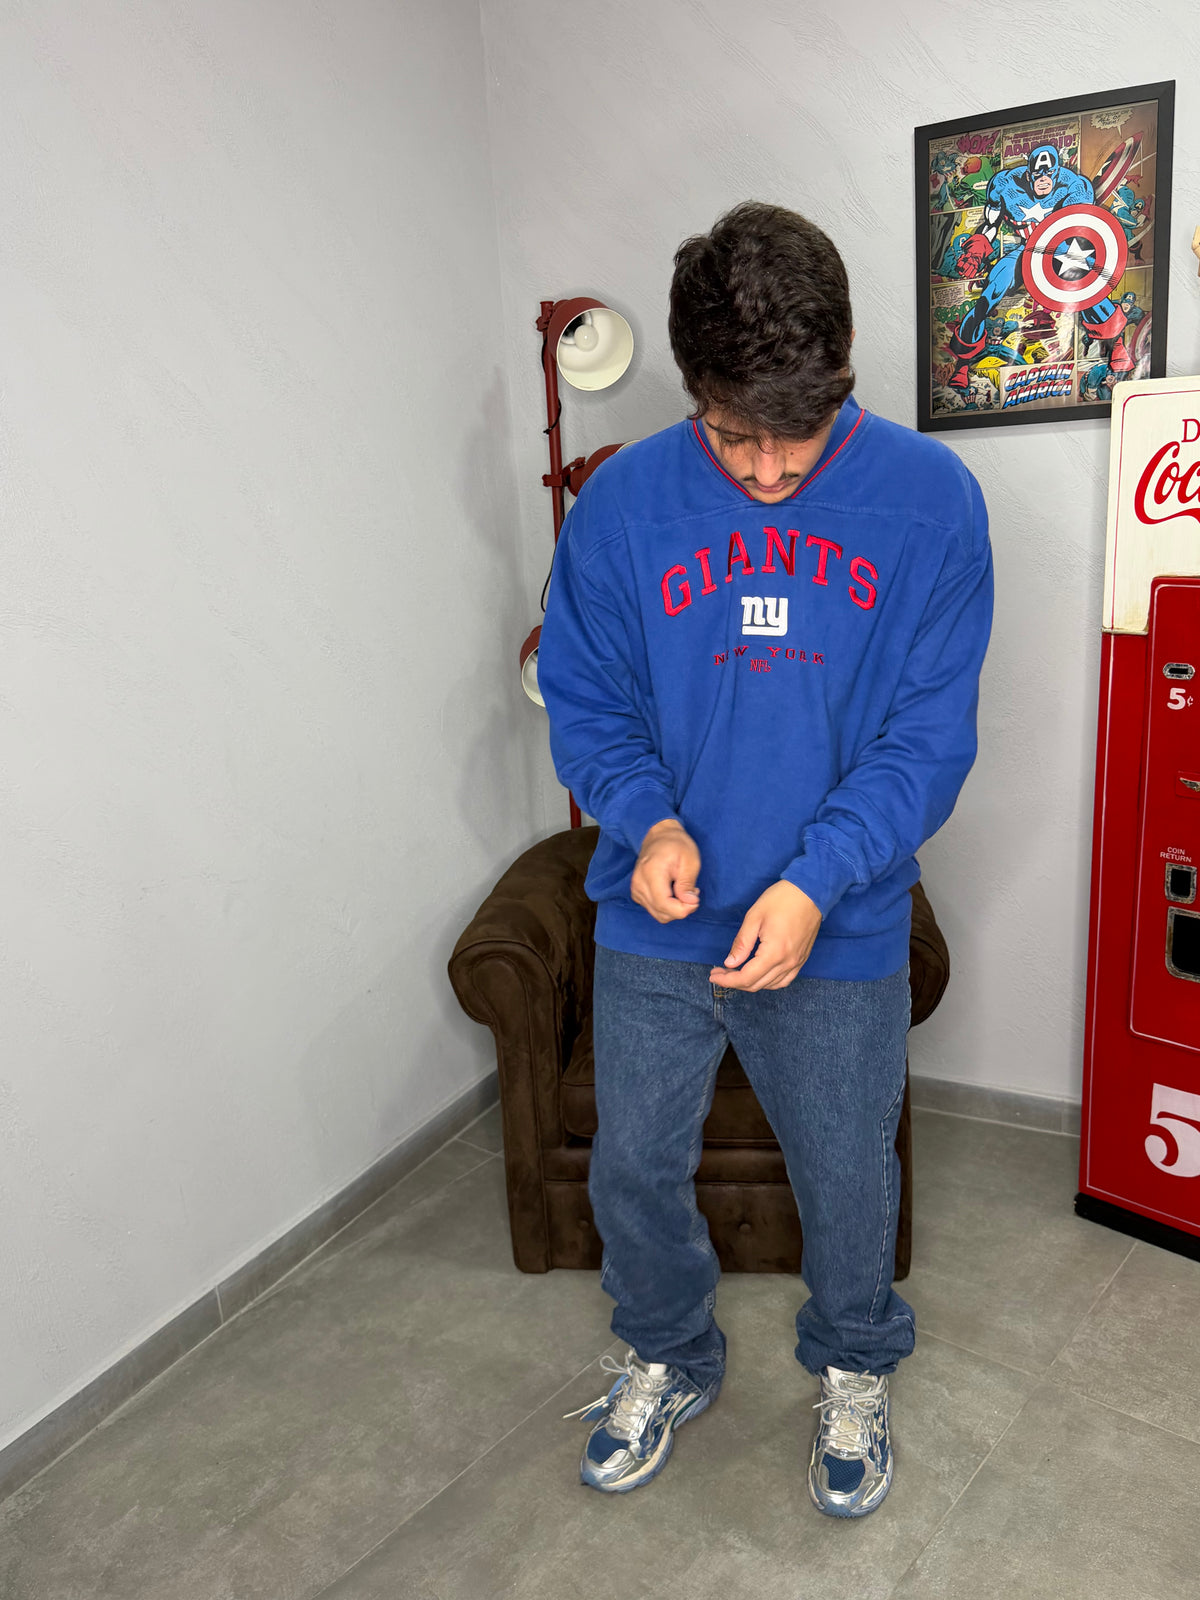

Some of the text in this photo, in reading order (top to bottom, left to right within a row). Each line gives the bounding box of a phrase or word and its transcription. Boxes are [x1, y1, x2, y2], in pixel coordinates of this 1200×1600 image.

[1004, 363, 1075, 392] CAPTAIN
[1002, 380, 1073, 409] AMERICA
[1134, 441, 1200, 525] Coc
[661, 526, 879, 617] GIANTS
[766, 646, 825, 665] YORK
[1160, 851, 1192, 863] RETURN
[1167, 846, 1186, 855] COIN
